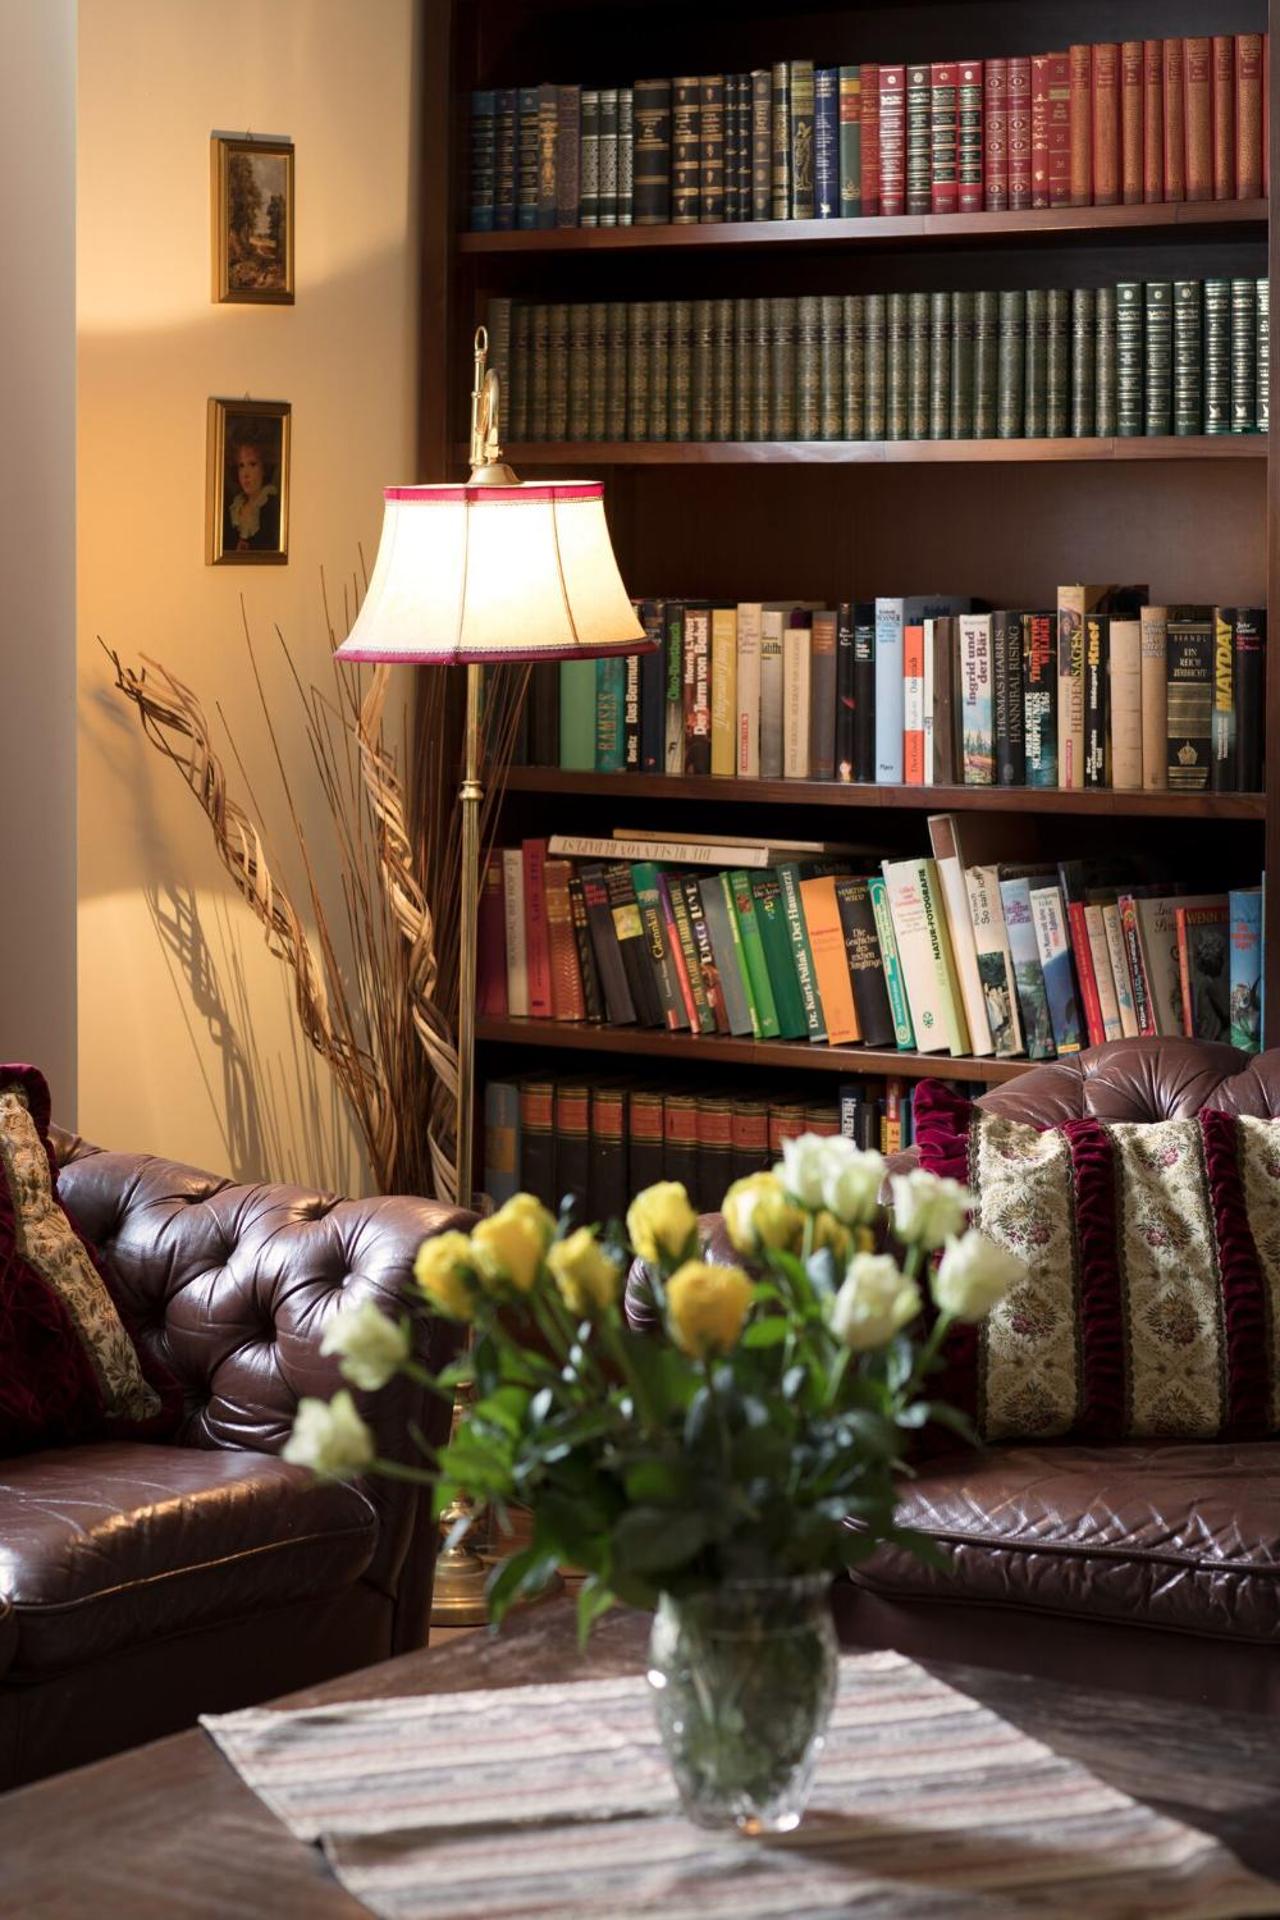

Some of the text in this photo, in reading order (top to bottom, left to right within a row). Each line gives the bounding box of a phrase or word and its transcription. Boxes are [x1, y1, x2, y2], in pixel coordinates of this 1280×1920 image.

[975, 631, 988, 684] der Bär
[1031, 616, 1041, 682] THORNTON
[1041, 618, 1050, 665] WILDER
[1088, 621, 1101, 665] Knef
[1215, 617, 1233, 712] MAYDAY
[684, 653, 695, 684] Morris
[694, 617, 707, 735] Der Turm von Babel
[964, 631, 979, 707] Ingrid und
[995, 629, 1007, 738] THOMAS HARRIS
[1008, 626, 1021, 743] HANNIBAL RISING
[1070, 629, 1083, 733] HELDENSAGEN
[598, 692, 617, 751] RAMSES
[626, 703, 639, 723] Das
[1041, 692, 1050, 713] TAG
[561, 839, 618, 856] BUDAPEST
[620, 842, 640, 857] VON
[692, 847, 711, 861] DIE
[781, 871, 800, 920] Hausarzt
[918, 869, 942, 960] NATUR-FOTOGRAFIE
[977, 891, 989, 908] sah
[980, 910, 991, 925] So
[645, 907, 665, 959] Glennkill
[792, 922, 804, 942] Der
[803, 984, 816, 1010] Kurt
[808, 1010, 819, 1029] Dr.
